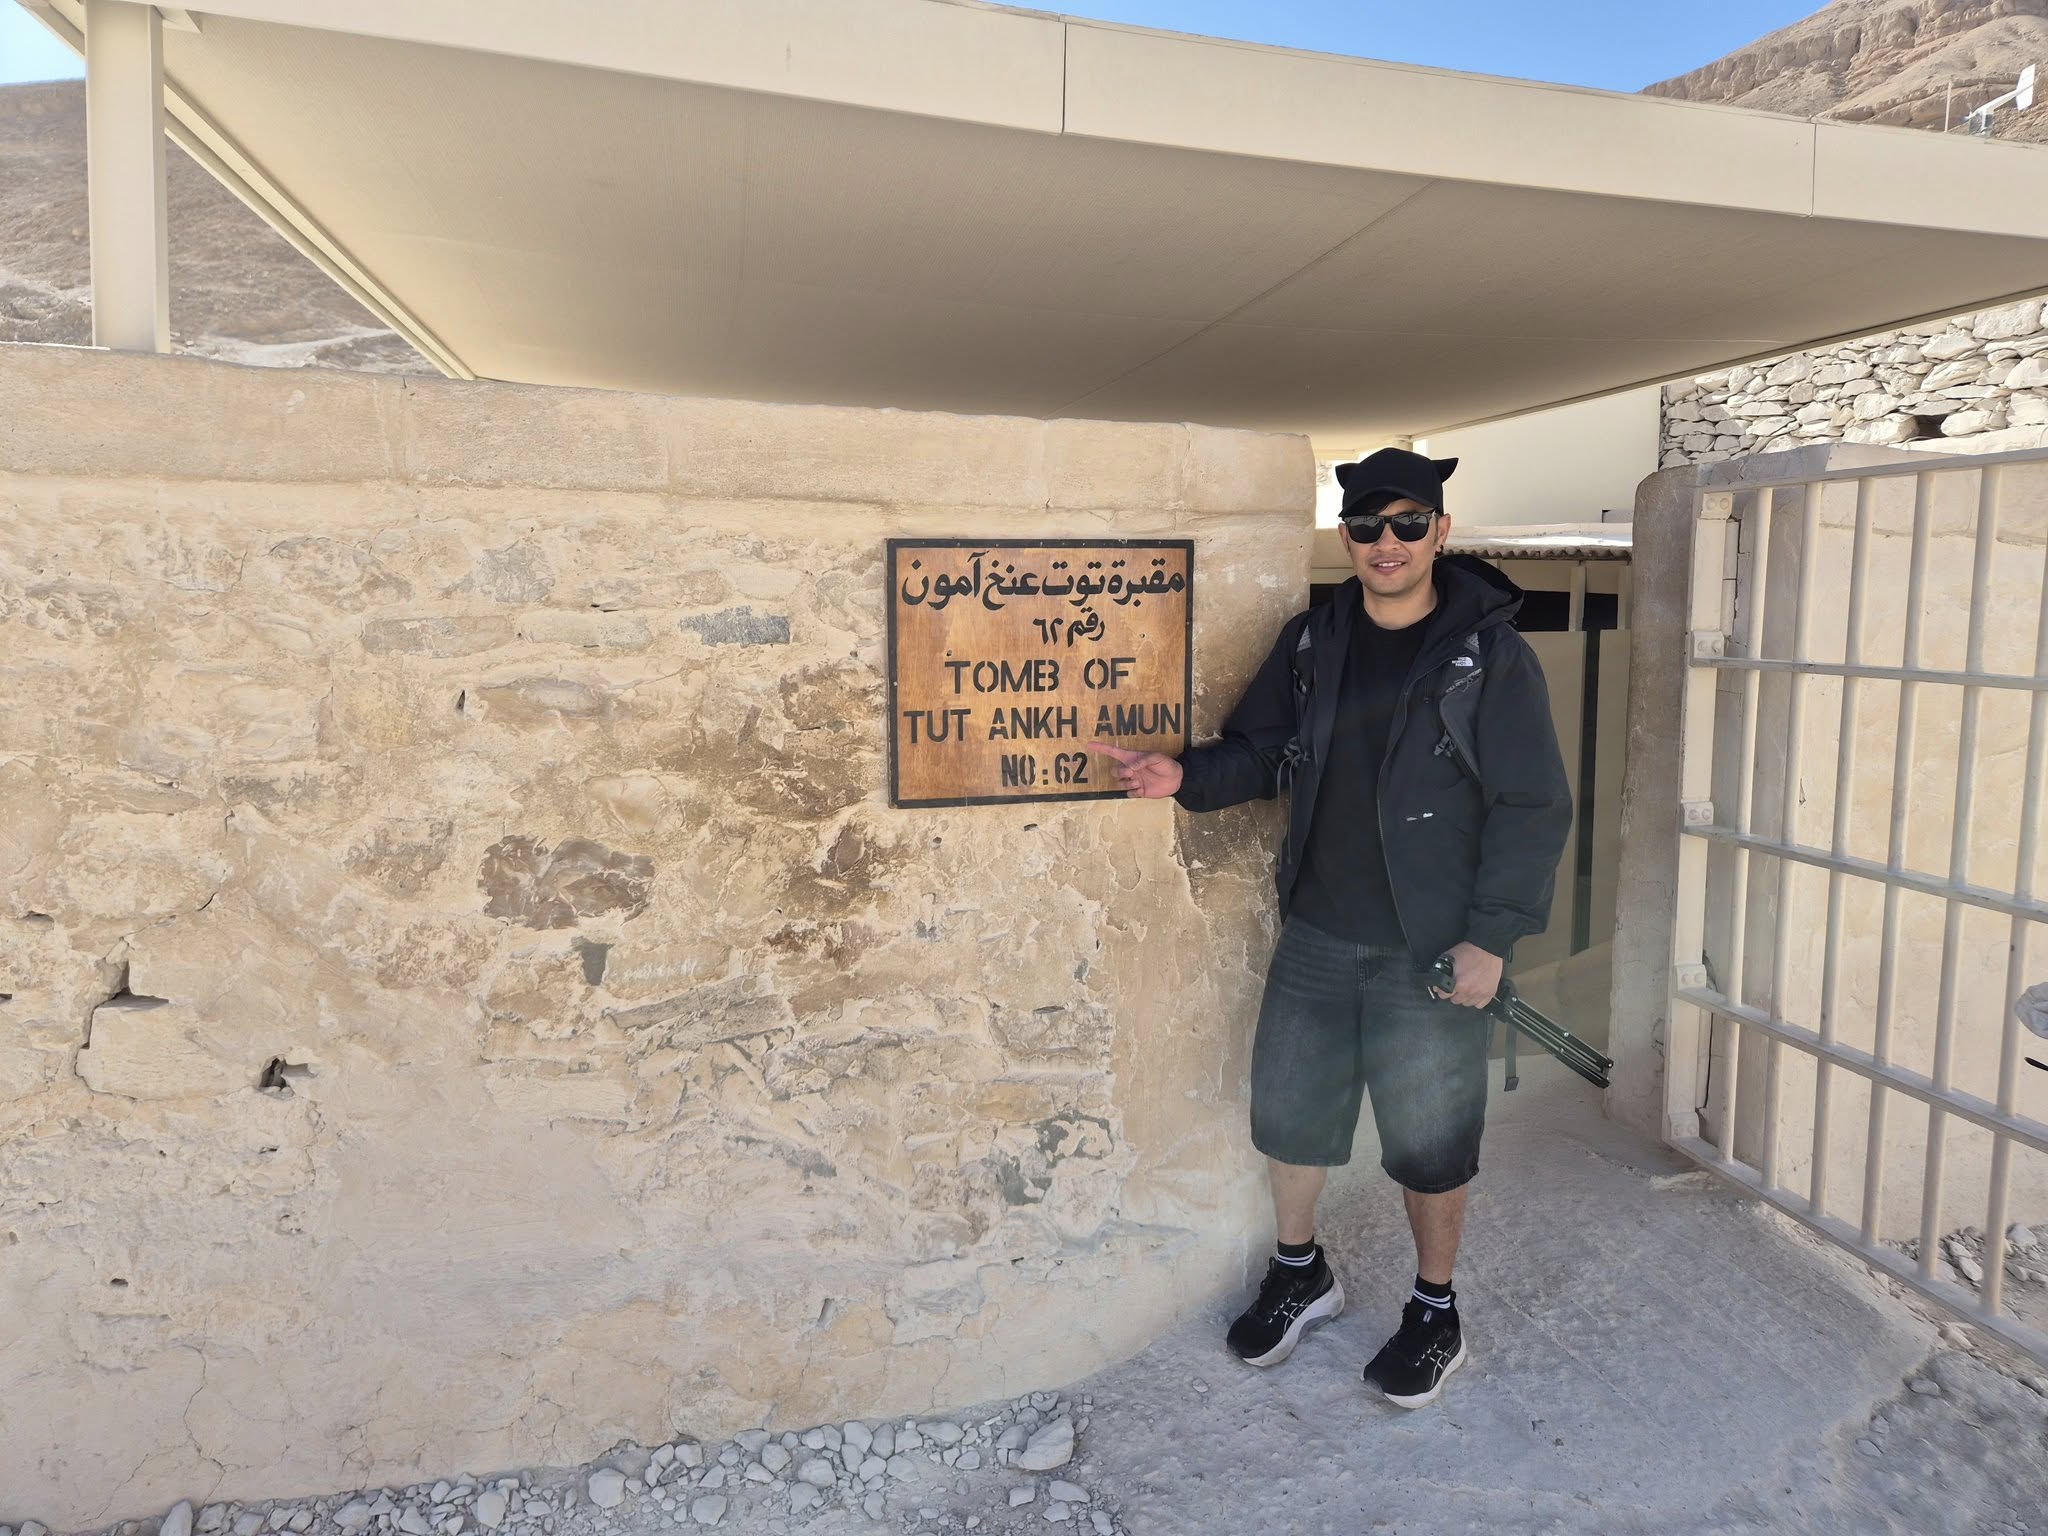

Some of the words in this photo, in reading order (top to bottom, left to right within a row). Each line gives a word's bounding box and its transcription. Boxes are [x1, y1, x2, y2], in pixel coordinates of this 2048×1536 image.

[901, 550, 990, 611] آمون
[982, 559, 1041, 611] عنخ
[1041, 560, 1106, 607] توت
[1107, 558, 1186, 607] مقبرة
[1032, 617, 1064, 646] ٦٢
[1067, 606, 1106, 648] رقم
[944, 659, 1060, 694] TOMB
[1083, 657, 1136, 690] OF
[903, 708, 972, 744] TUT
[988, 706, 1078, 741] ANKH
[1094, 703, 1181, 737] AMUN
